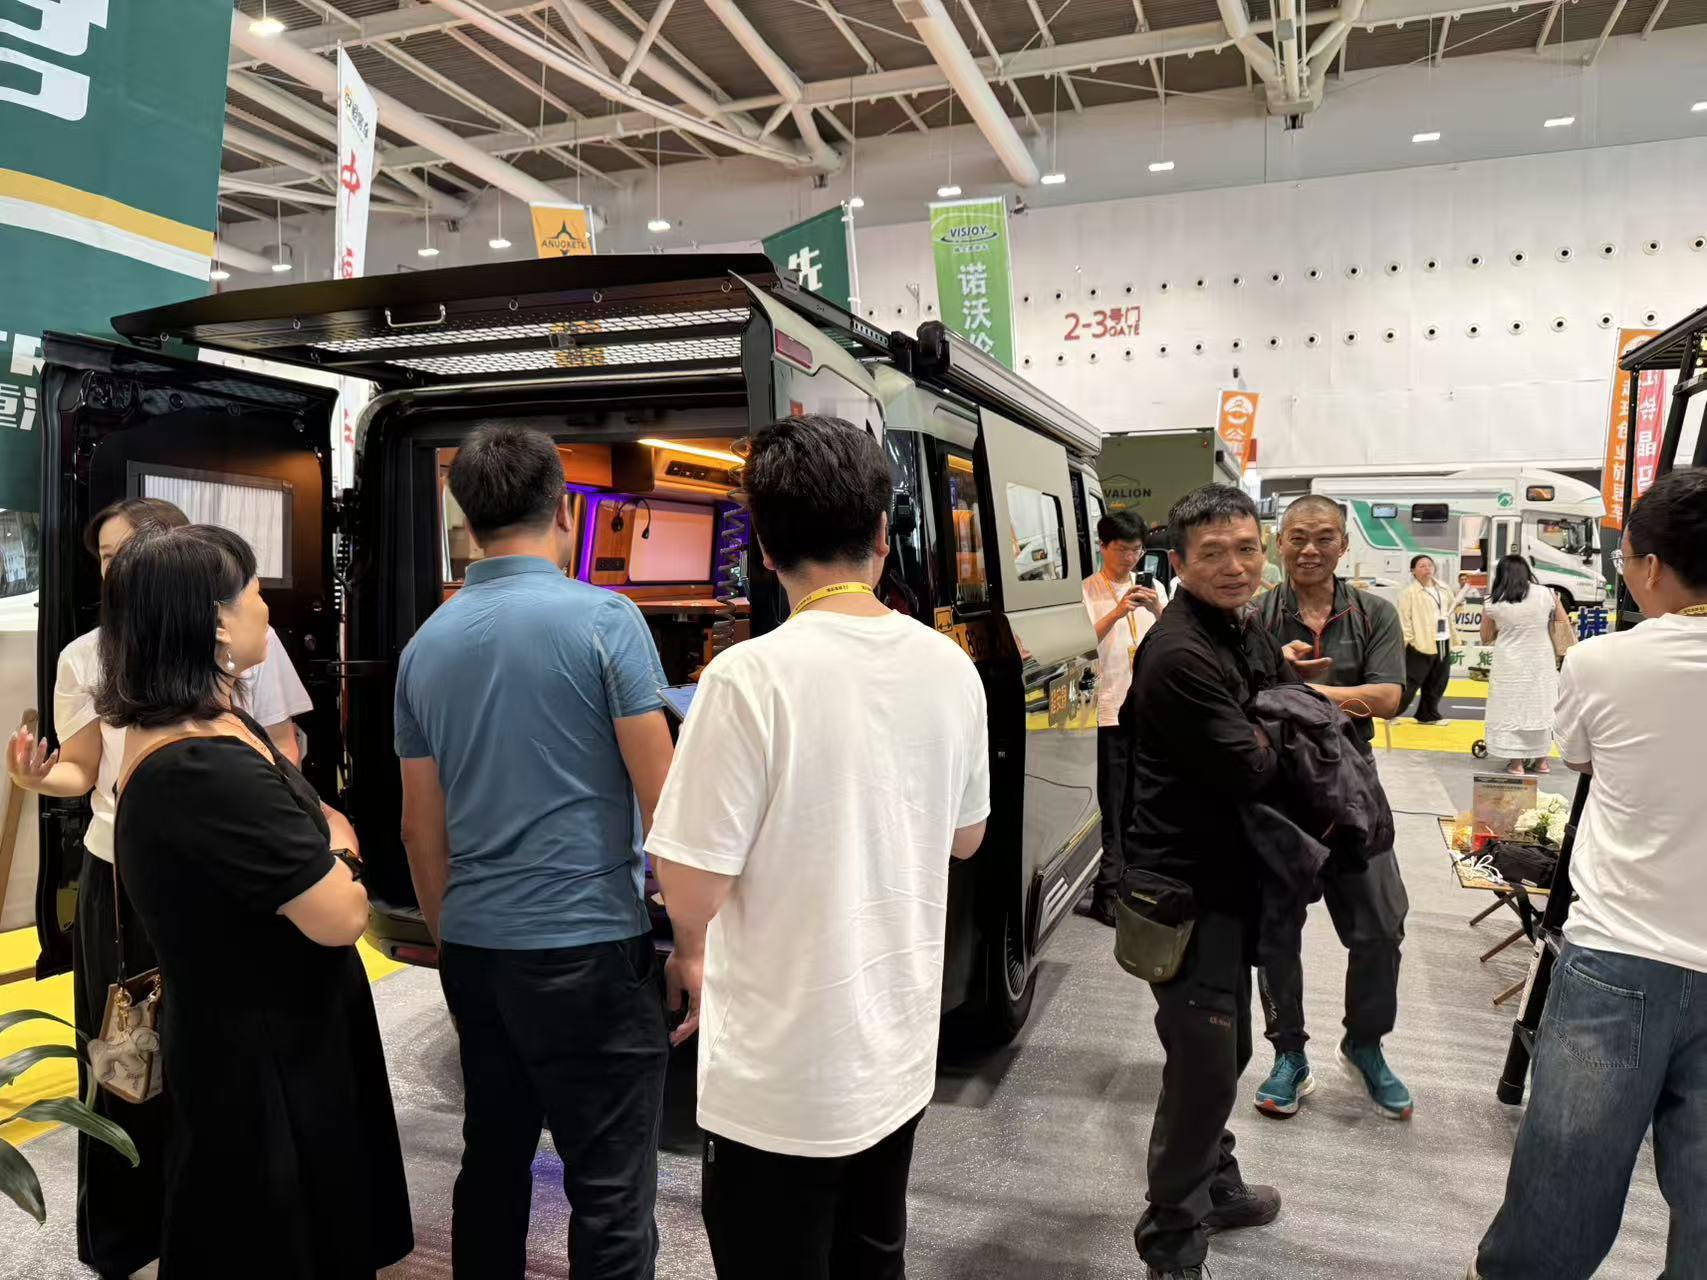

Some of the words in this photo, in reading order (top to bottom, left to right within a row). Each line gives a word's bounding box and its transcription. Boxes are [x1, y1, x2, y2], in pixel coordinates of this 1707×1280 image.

[950, 225, 987, 238] VISJOY
[1064, 309, 1108, 341] 2-3
[1108, 322, 1140, 337] GATE
[1455, 611, 1482, 626] VISJO
